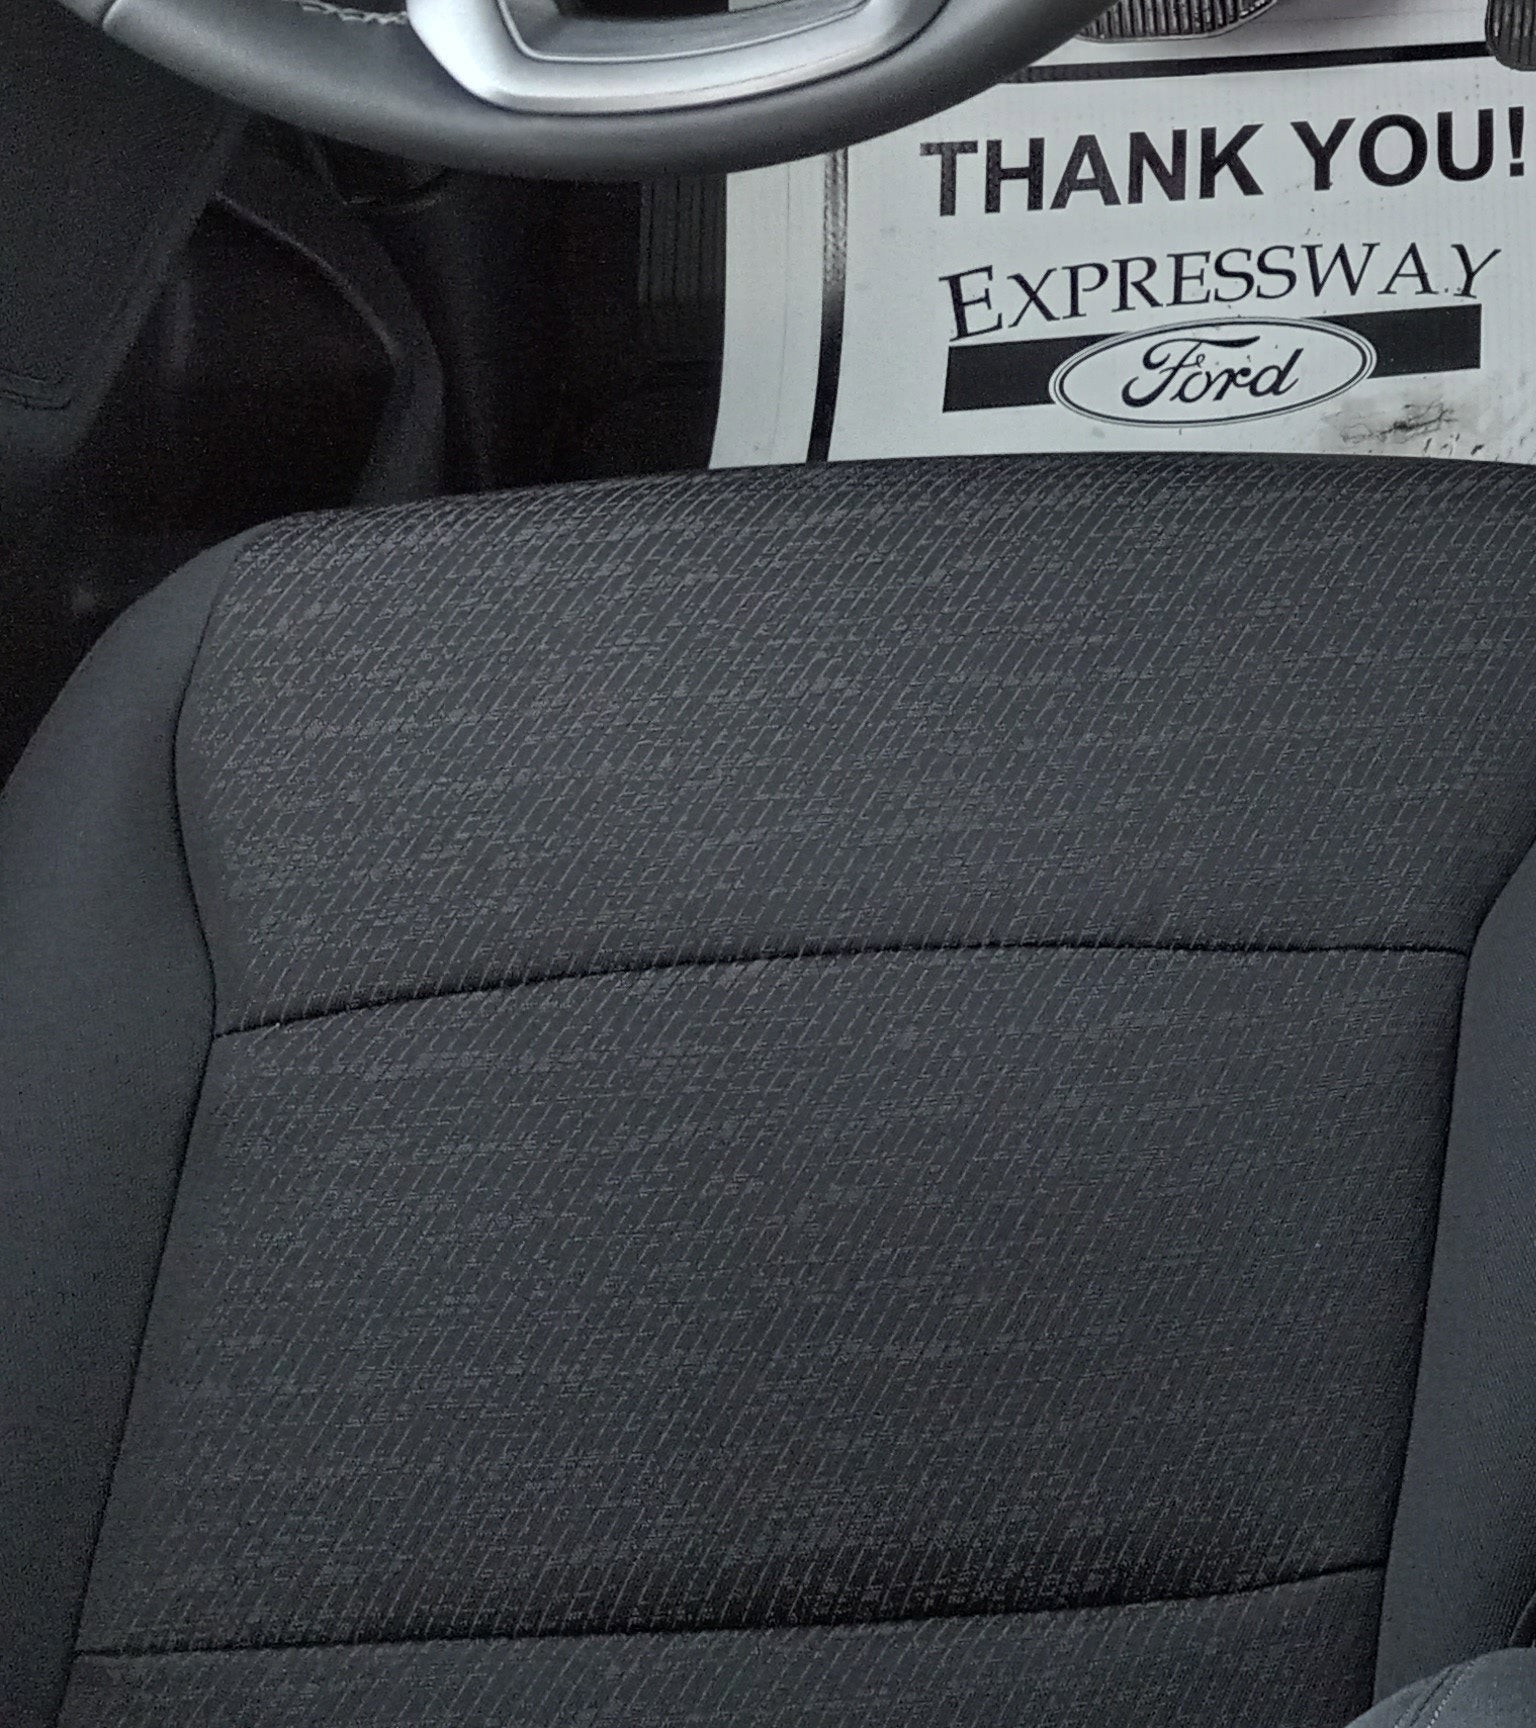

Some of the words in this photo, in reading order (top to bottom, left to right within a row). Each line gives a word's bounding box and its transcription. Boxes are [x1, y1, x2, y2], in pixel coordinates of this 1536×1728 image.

[919, 122, 1265, 217] THANK
[1289, 105, 1527, 193] YOU!
[938, 241, 1503, 343] EXPRESSWAY
[1119, 333, 1301, 409] Ford
